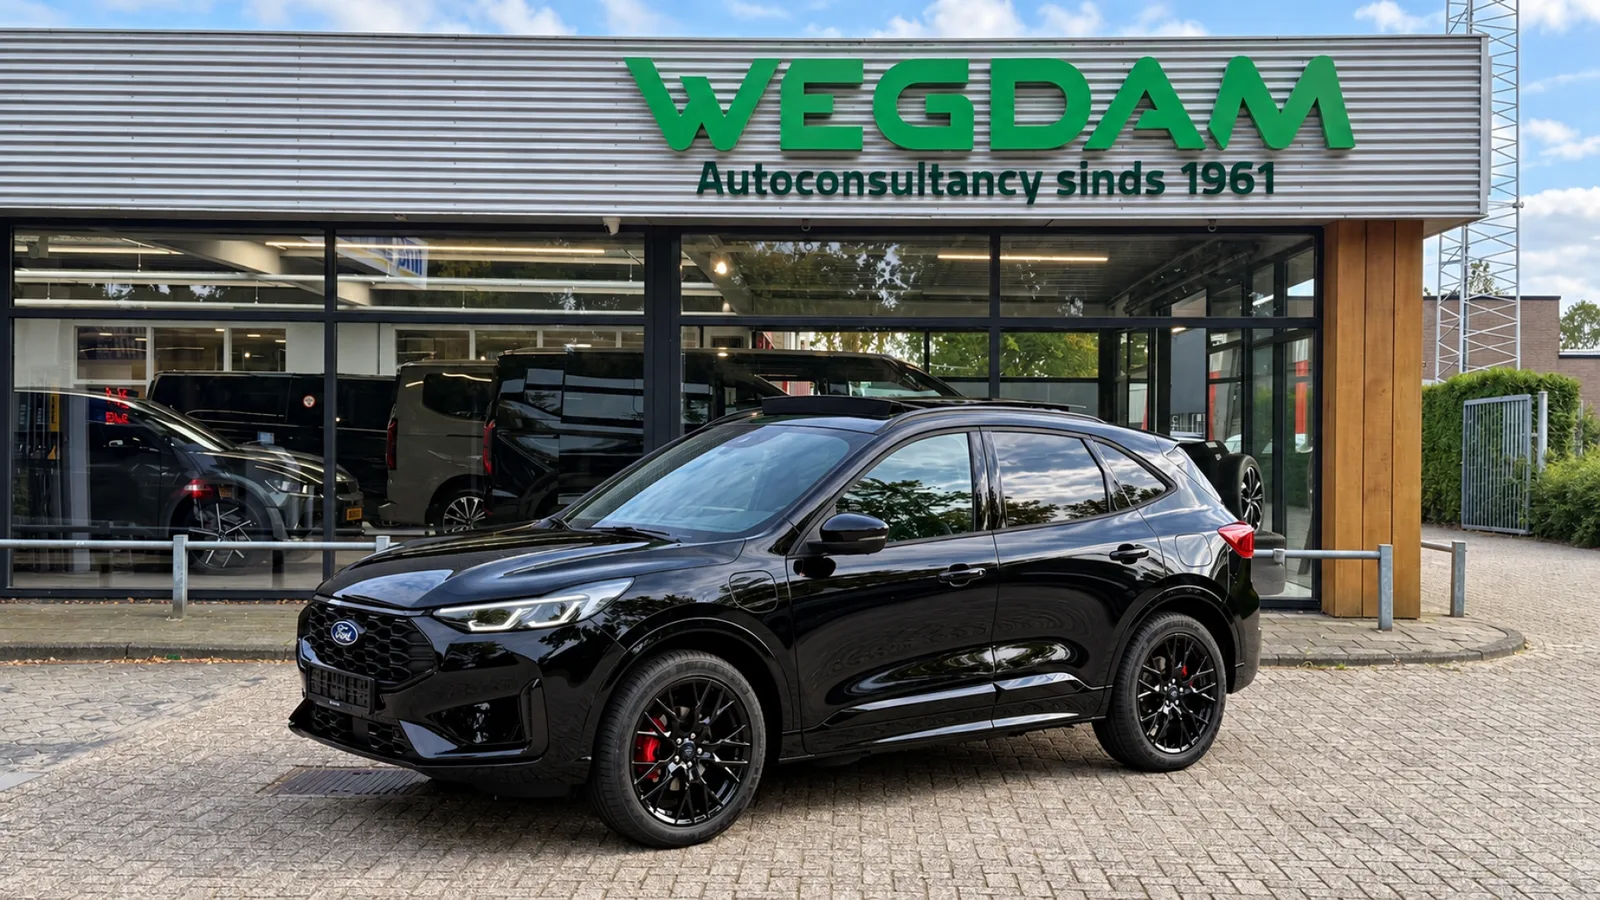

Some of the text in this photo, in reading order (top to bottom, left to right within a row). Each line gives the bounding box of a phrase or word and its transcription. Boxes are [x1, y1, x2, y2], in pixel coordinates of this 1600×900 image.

[624, 55, 1356, 151] WEGDAM
[696, 160, 1275, 206] Autoconsultancy sinds 1961
[334, 624, 353, 642] Ford
